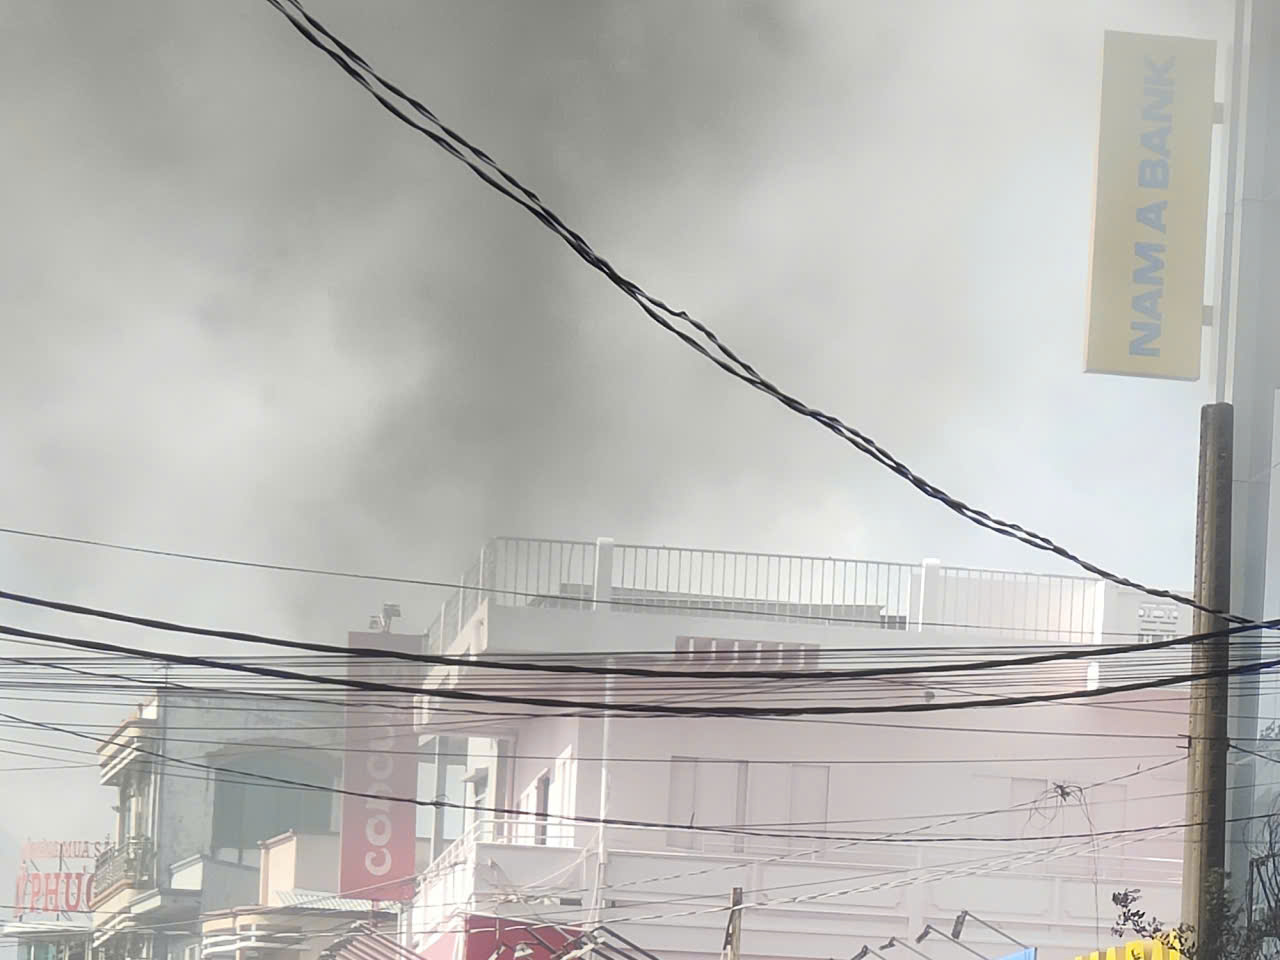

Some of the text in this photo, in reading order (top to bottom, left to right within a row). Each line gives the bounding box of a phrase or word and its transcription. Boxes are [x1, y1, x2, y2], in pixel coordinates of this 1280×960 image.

[1129, 56, 1176, 357] NAM A BANK
